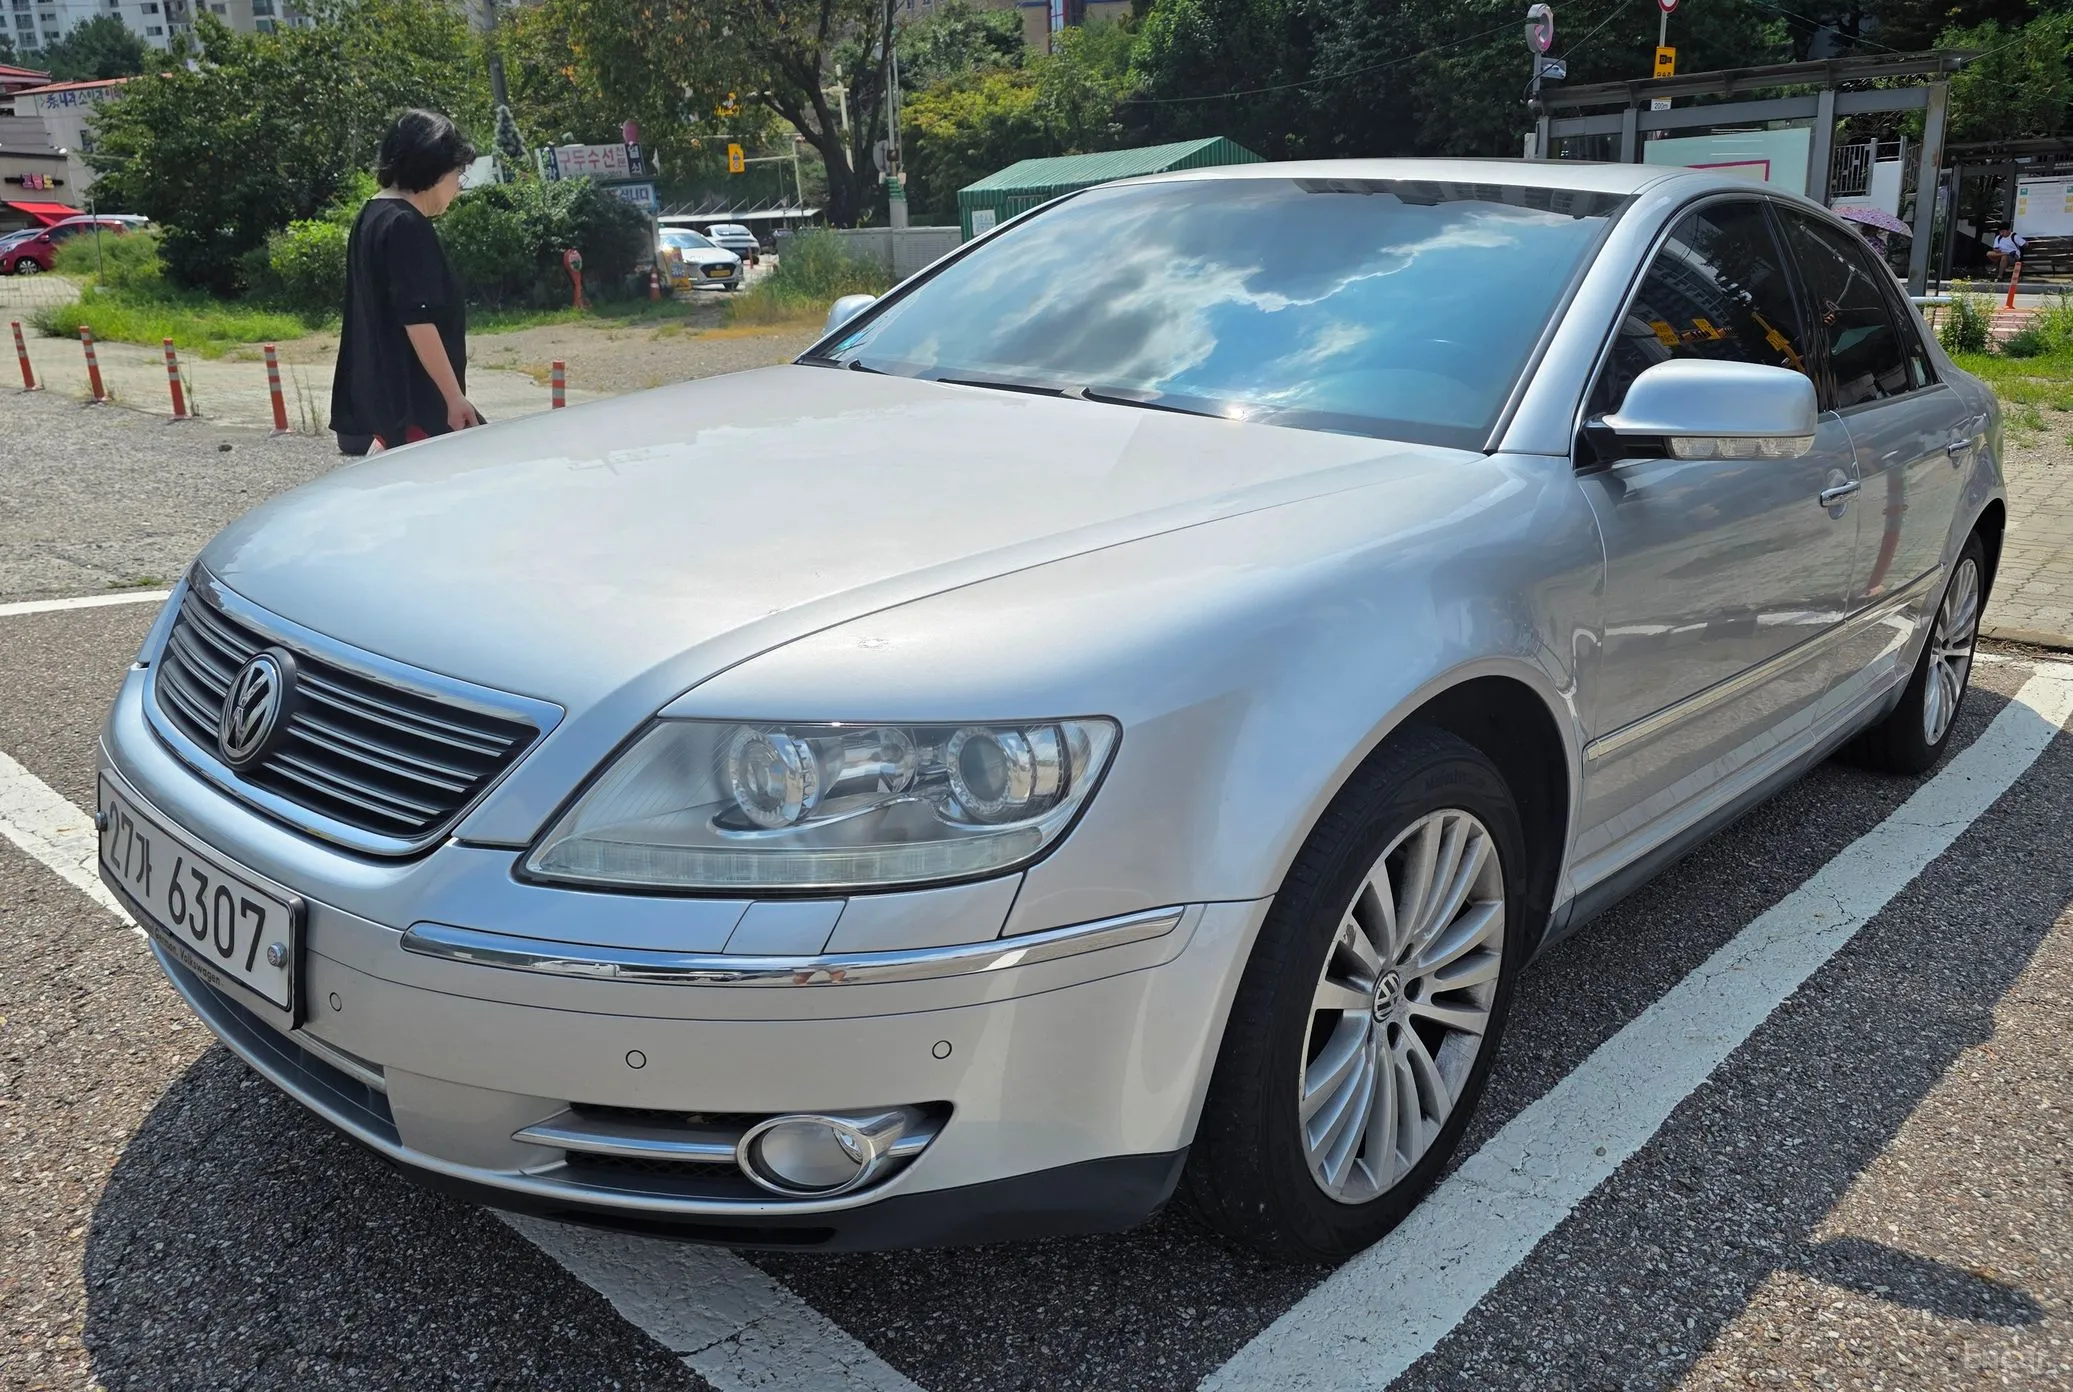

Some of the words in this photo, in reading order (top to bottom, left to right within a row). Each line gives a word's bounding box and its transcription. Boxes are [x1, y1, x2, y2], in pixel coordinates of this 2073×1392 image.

[557, 147, 616, 172] 구두수선
[109, 800, 153, 898] 27가
[168, 857, 266, 972] 6307
